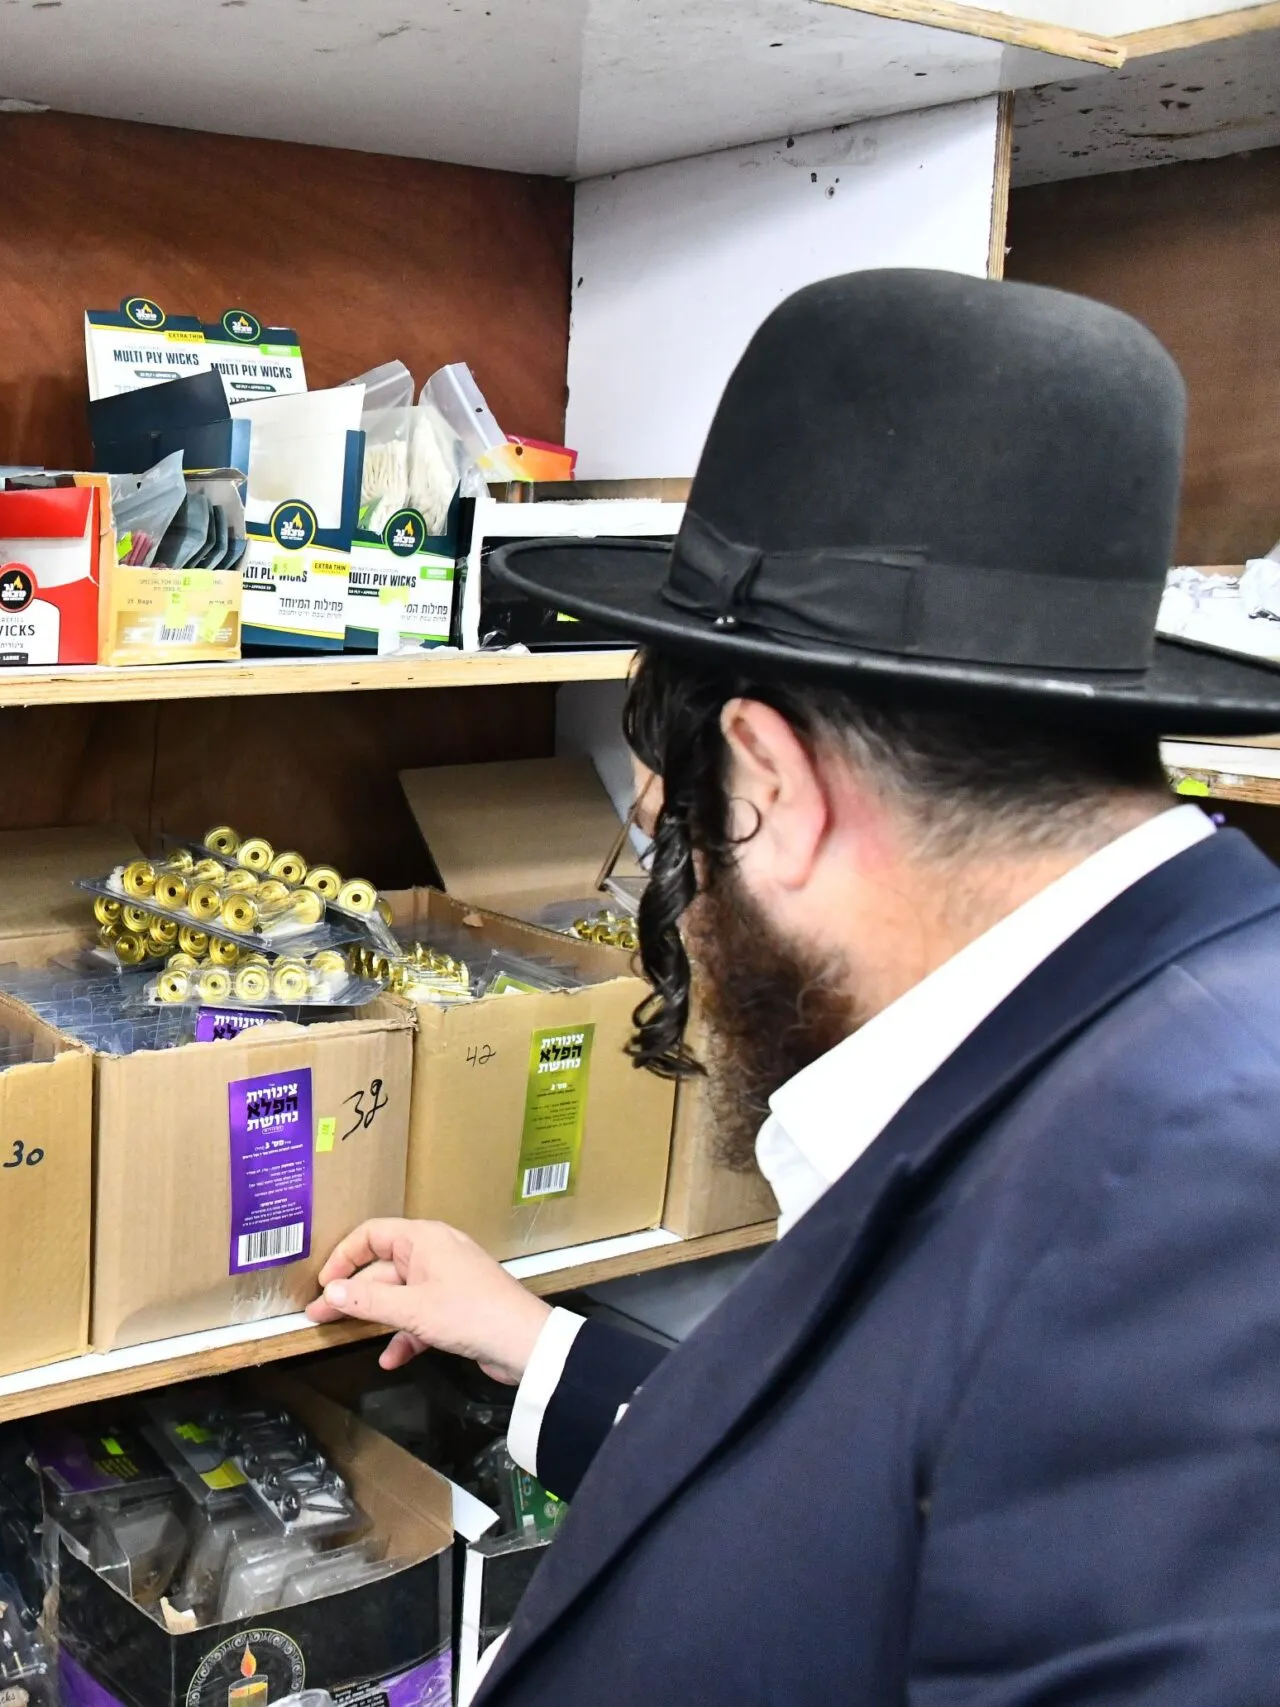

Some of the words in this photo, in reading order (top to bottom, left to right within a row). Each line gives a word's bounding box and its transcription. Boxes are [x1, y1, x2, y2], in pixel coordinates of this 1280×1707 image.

[113, 349, 142, 363] MULTI
[147, 351, 162, 364] PLY
[165, 353, 199, 366] WICKS
[211, 362, 238, 376] MULTI
[242, 364, 257, 377] PLY
[259, 366, 292, 379] WICKS
[314, 562, 332, 570] EXTRA
[373, 573, 387, 586] PLY
[390, 575, 417, 587] WICKS
[280, 597, 310, 609] המיוחד
[314, 599, 343, 612] פתילות
[422, 603, 448, 615] פתילות
[541, 1033, 584, 1049] צינורית
[466, 1044, 496, 1067] 42
[539, 1045, 582, 1063] הפלא
[537, 1059, 581, 1073] נחושת
[246, 1082, 298, 1104] צינורית
[247, 1096, 298, 1118] הפלא
[247, 1111, 298, 1131] נחושת
[3, 1140, 44, 1168] 30
